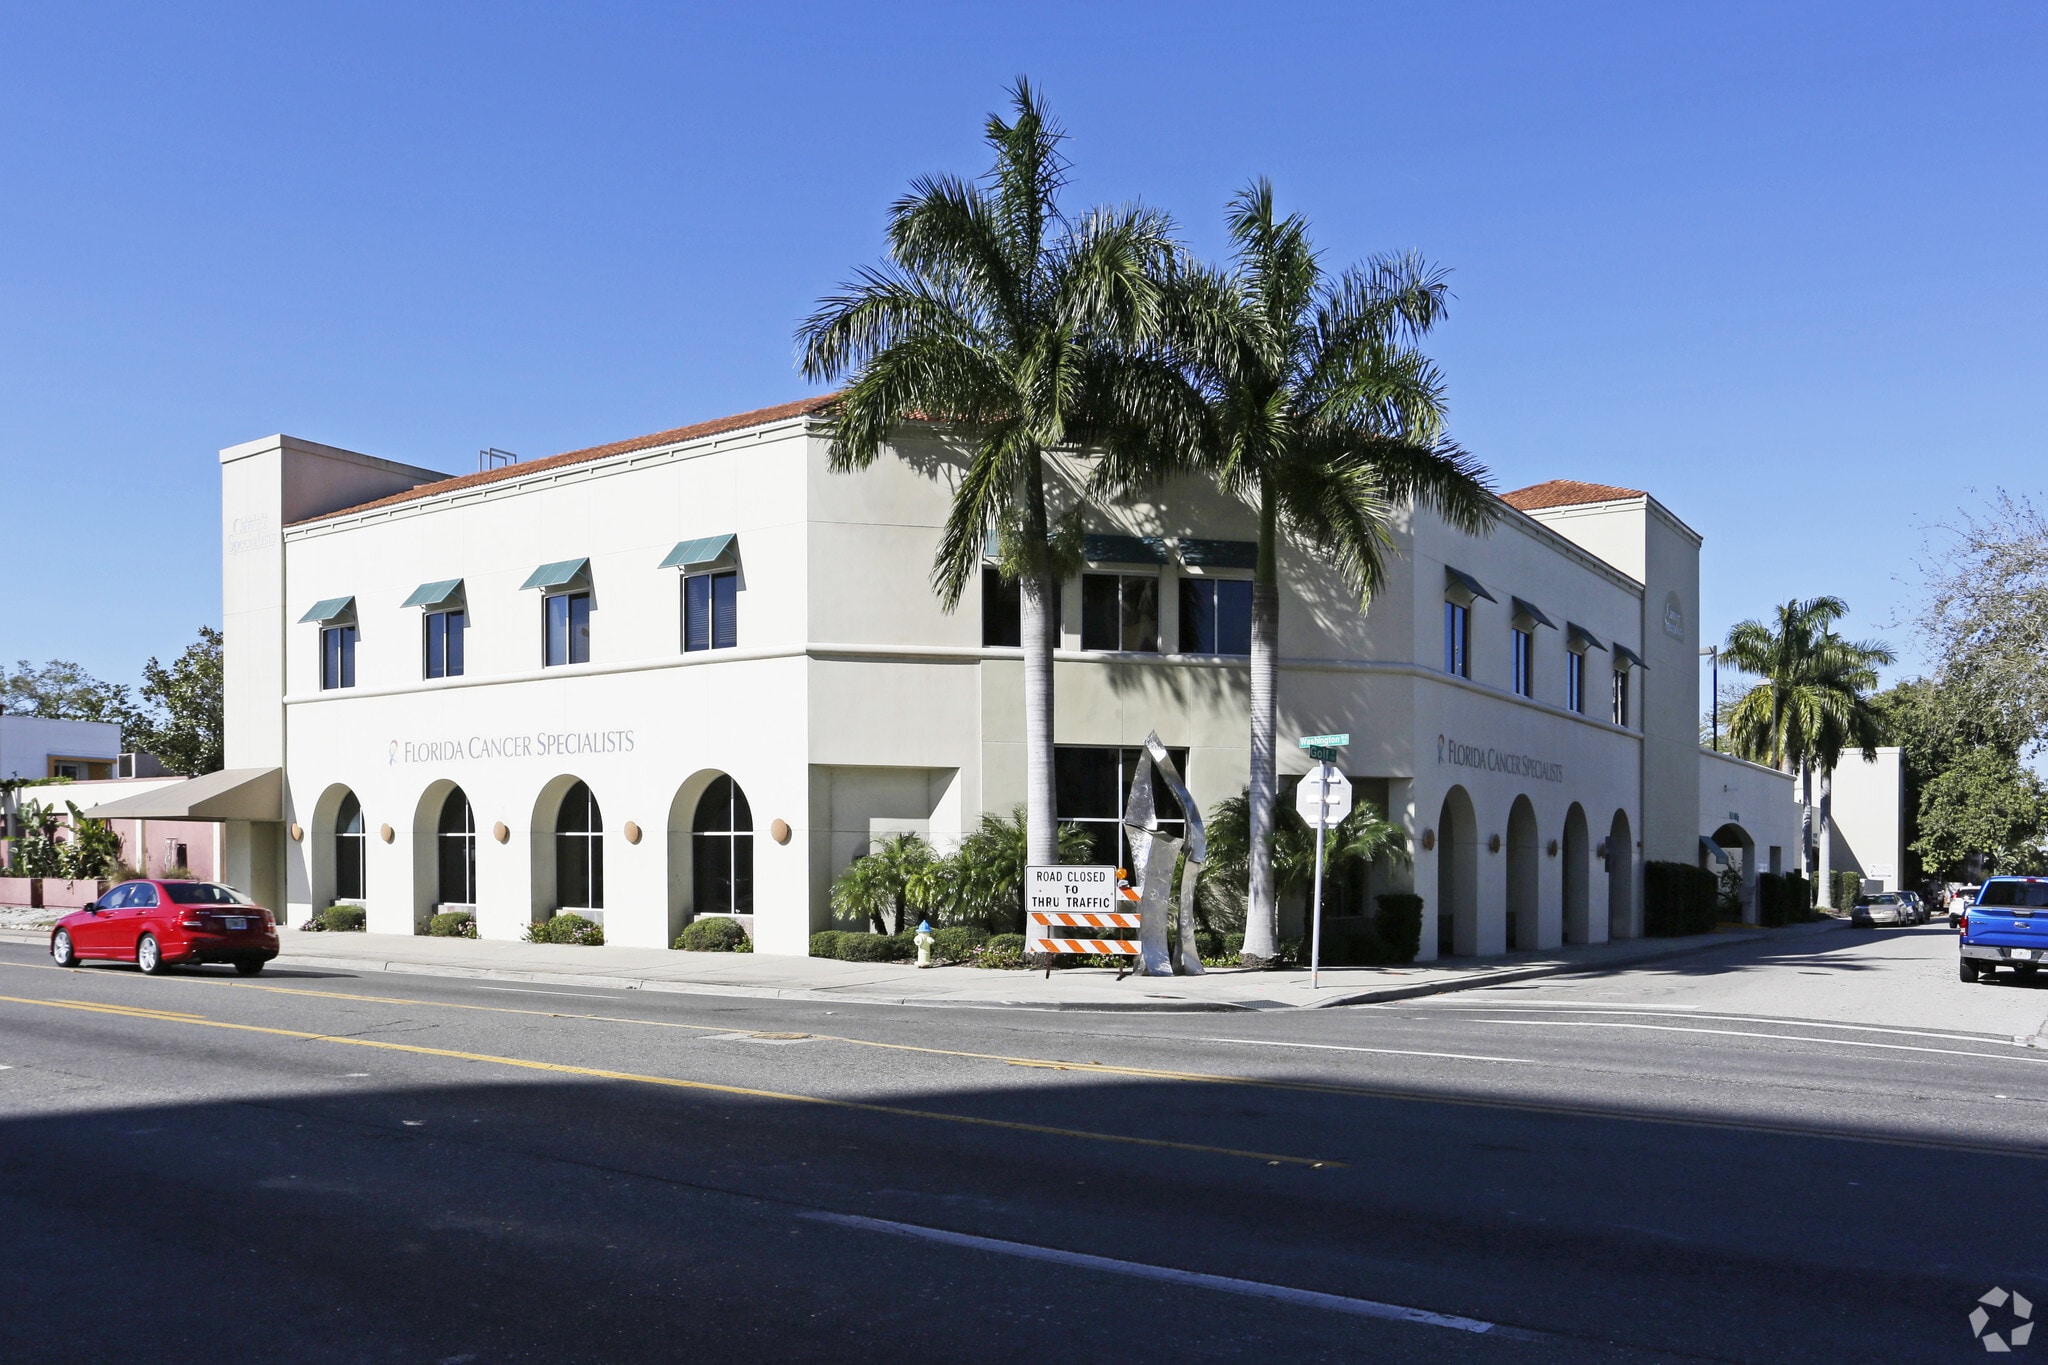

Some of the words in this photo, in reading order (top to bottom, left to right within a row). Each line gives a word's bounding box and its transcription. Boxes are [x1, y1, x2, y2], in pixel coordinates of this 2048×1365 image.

[404, 740, 464, 763] FLORIDA
[468, 736, 532, 759] CANCER
[537, 730, 635, 755] SPECIALISTS
[1300, 736, 1340, 746] Washington
[1310, 746, 1330, 759] Golf
[1448, 739, 1486, 769] FLORIDA
[1488, 748, 1521, 775] CANCER
[1522, 755, 1563, 783] SPECIALISTS
[1036, 871, 1063, 882] ROAD
[1067, 871, 1106, 882] CLOSED
[1064, 885, 1079, 894] TO
[1032, 896, 1060, 907] THRU
[1067, 897, 1110, 908] TRAFFIC
